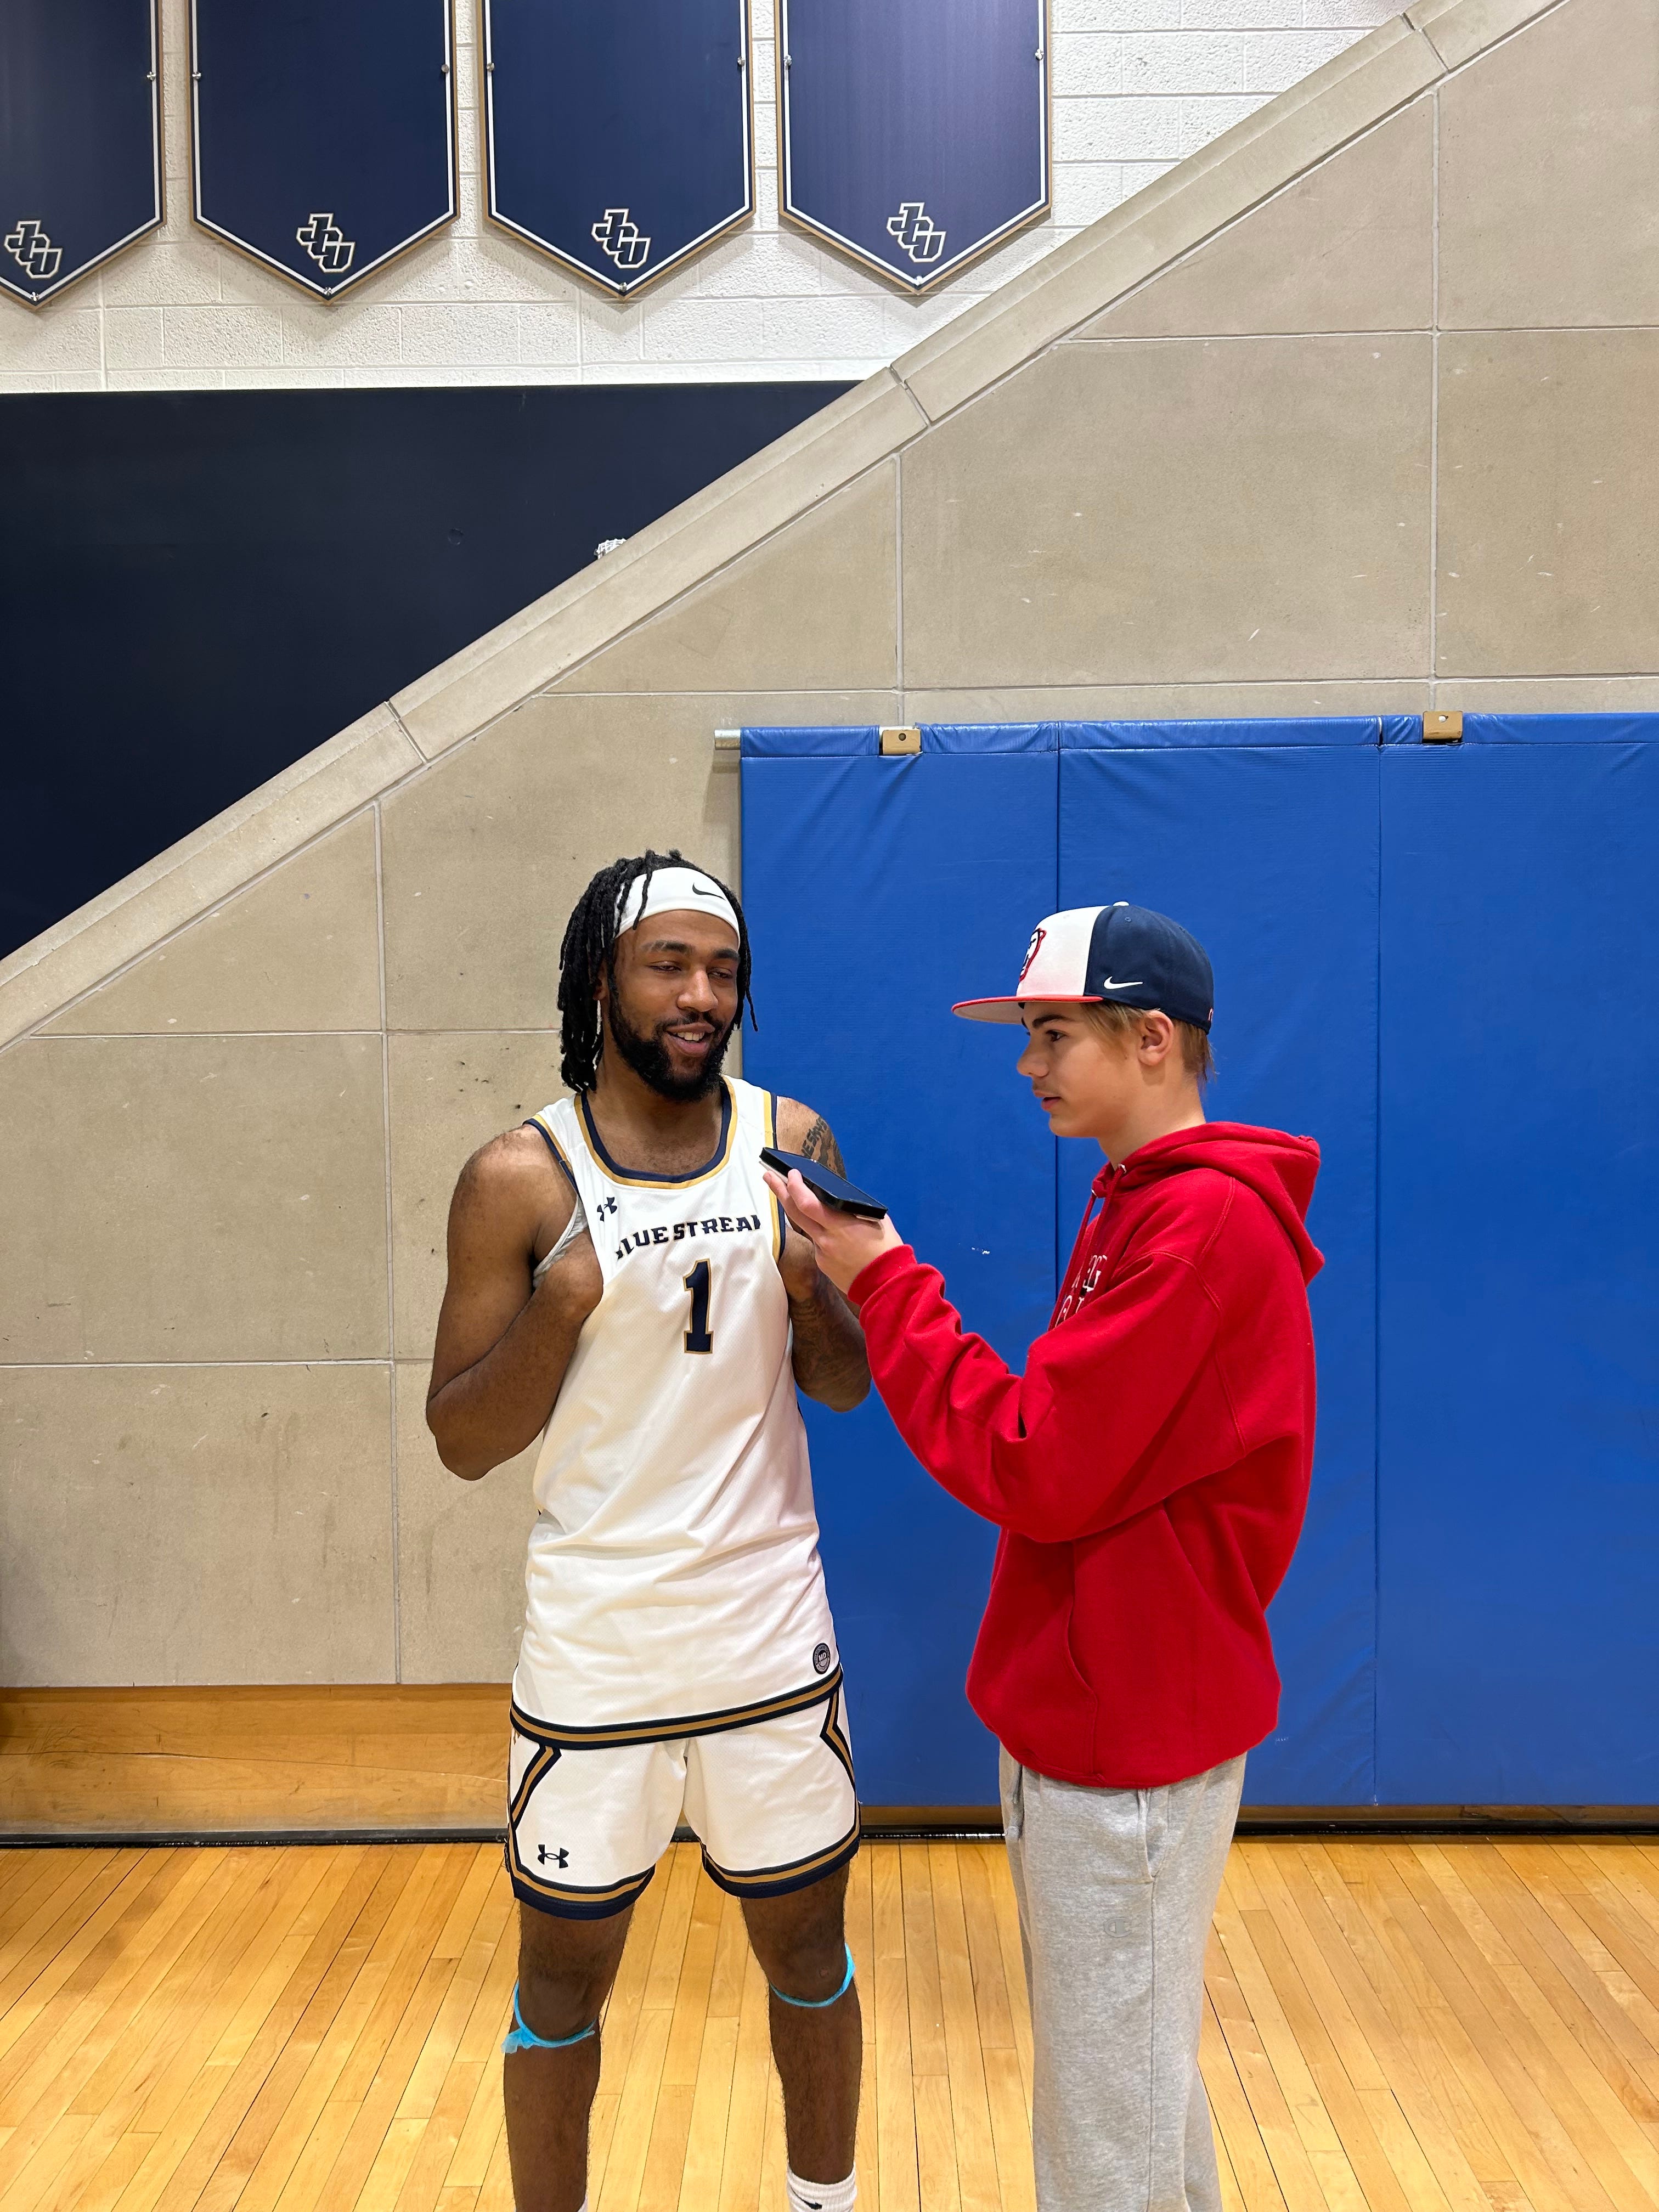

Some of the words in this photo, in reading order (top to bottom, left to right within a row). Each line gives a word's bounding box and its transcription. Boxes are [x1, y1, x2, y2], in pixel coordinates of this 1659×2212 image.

[4, 219, 63, 279] JCU
[296, 213, 356, 273] JCU
[591, 208, 651, 269] JCU
[886, 202, 946, 262] JCU
[616, 1226, 669, 1260] LUE
[683, 1258, 714, 1354] 1
